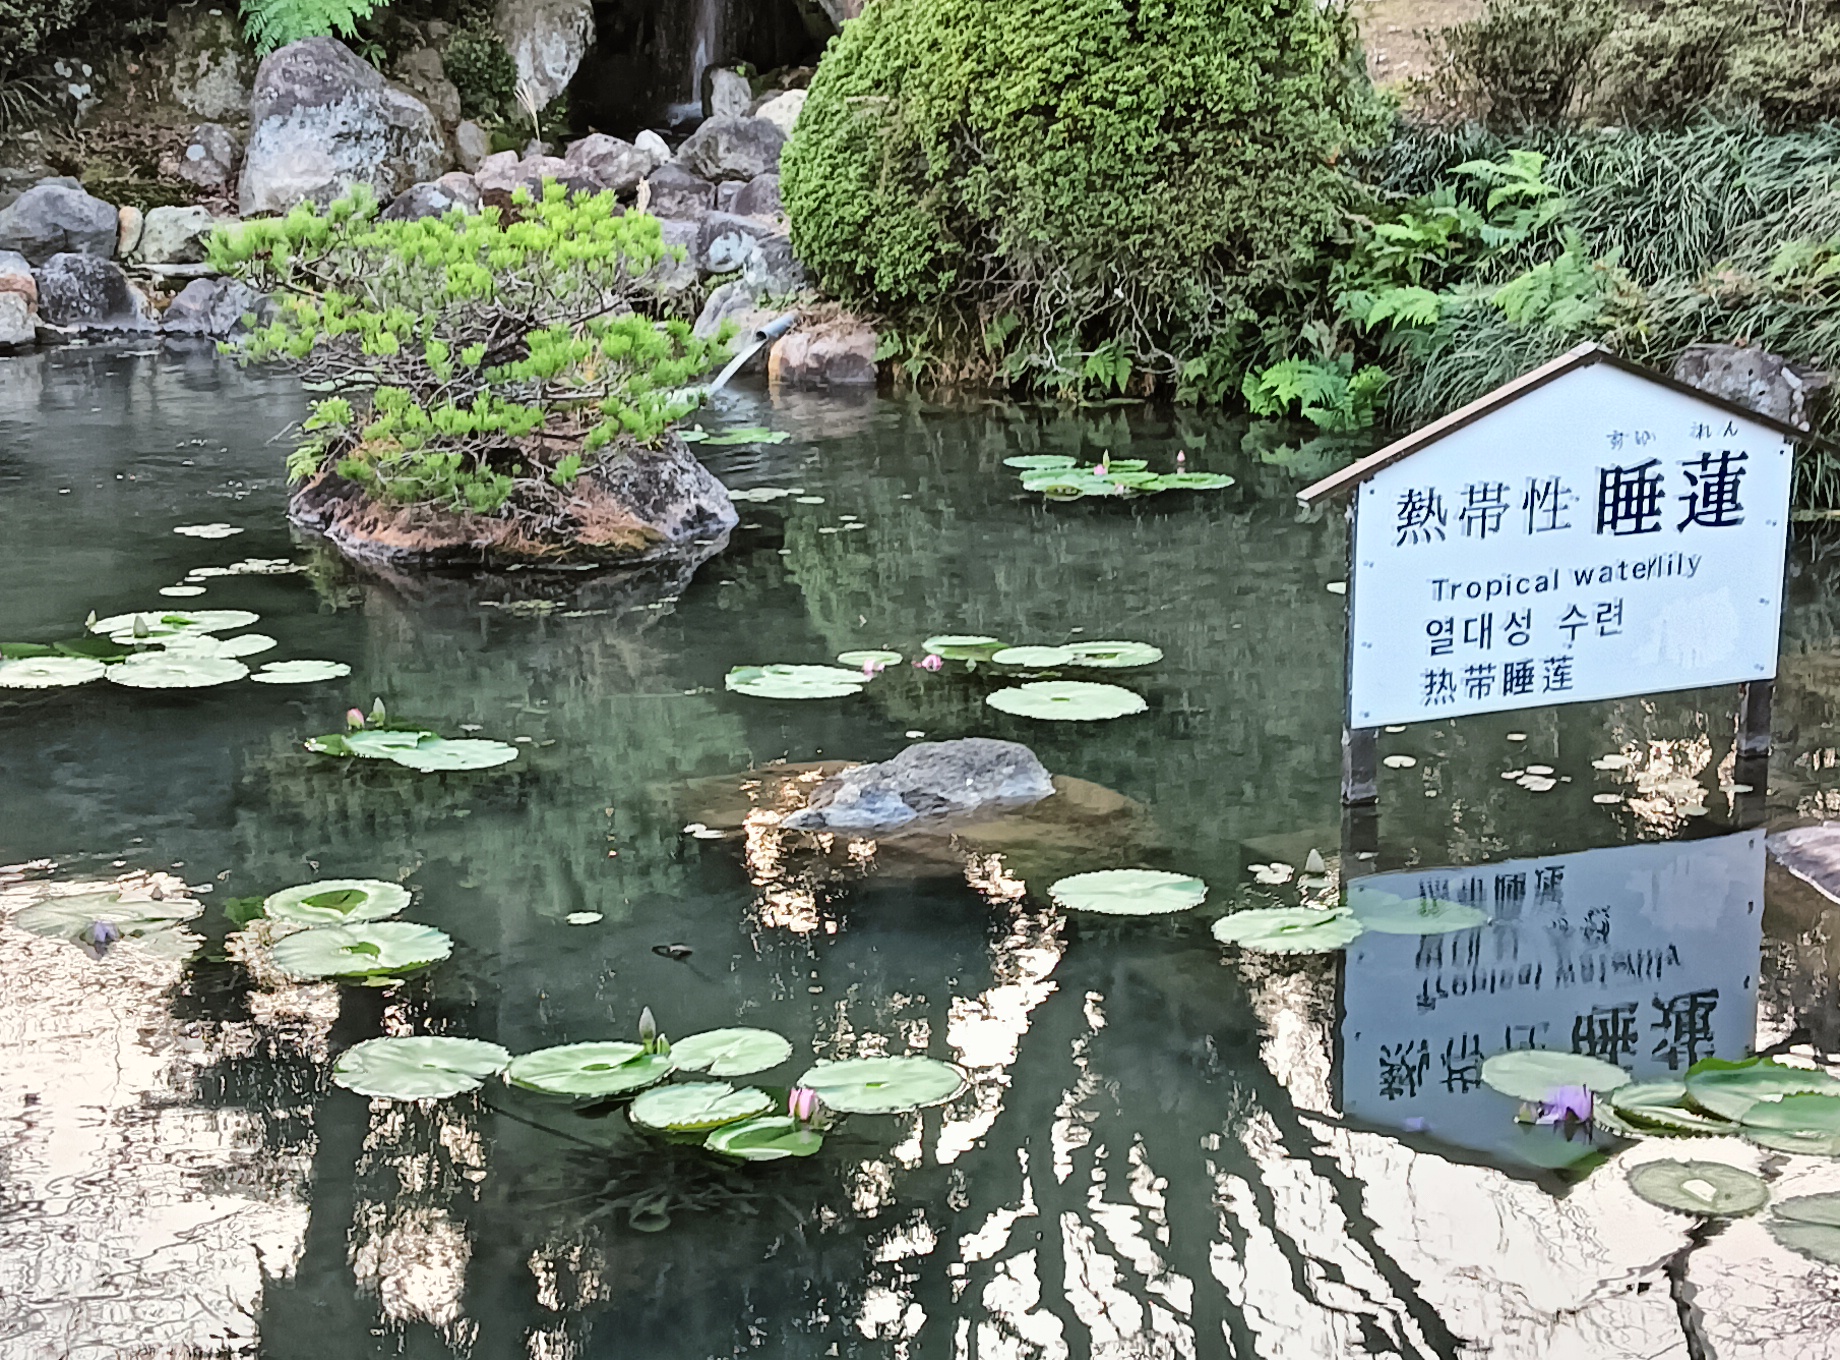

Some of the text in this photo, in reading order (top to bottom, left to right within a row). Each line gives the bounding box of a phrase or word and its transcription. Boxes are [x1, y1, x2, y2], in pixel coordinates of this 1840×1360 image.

[1396, 449, 1750, 548] 熱帯性 睡蓮
[1432, 567, 1560, 602] Tropical
[1425, 597, 1625, 657] 열대성 수련
[1423, 654, 1575, 708] 热带睡莲
